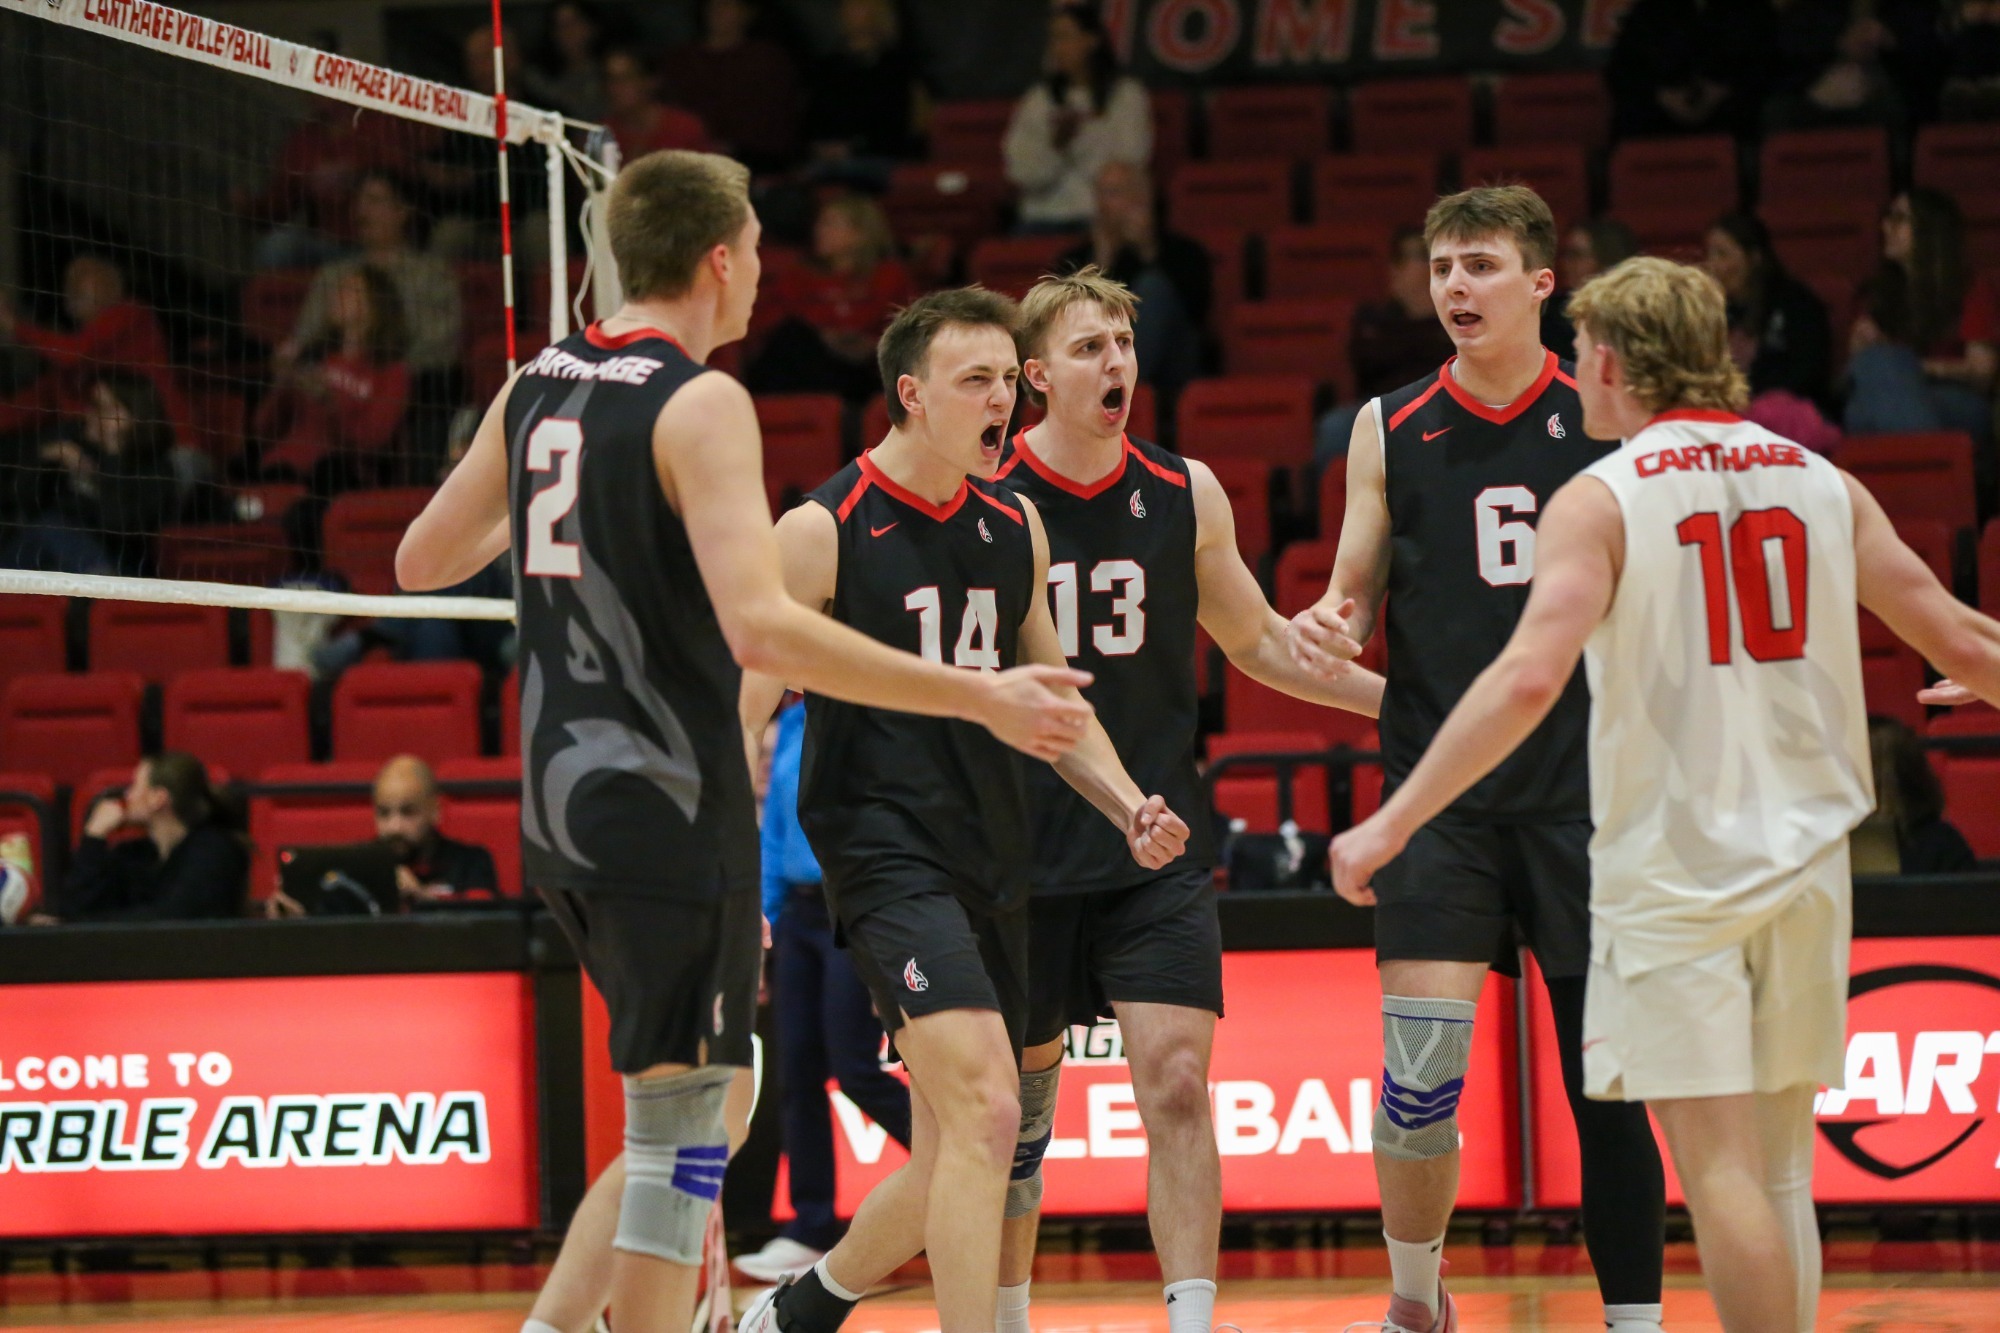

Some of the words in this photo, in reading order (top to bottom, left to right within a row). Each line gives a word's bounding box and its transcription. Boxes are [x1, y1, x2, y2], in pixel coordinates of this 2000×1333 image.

[175, 12, 271, 70] VOLLEYBALL
[313, 53, 387, 101] CARTHAGE
[388, 73, 469, 121] VOLLEYBALL
[526, 346, 665, 386] ARTHAGE
[1633, 443, 1807, 478] CARTHAGE
[523, 416, 584, 580] 2
[1474, 484, 1537, 588] 6
[1047, 558, 1146, 657] 13
[1675, 506, 1807, 665] 10
[903, 585, 1001, 675] 14
[168, 1052, 233, 1087] TO
[203, 1096, 485, 1164] ARENA
